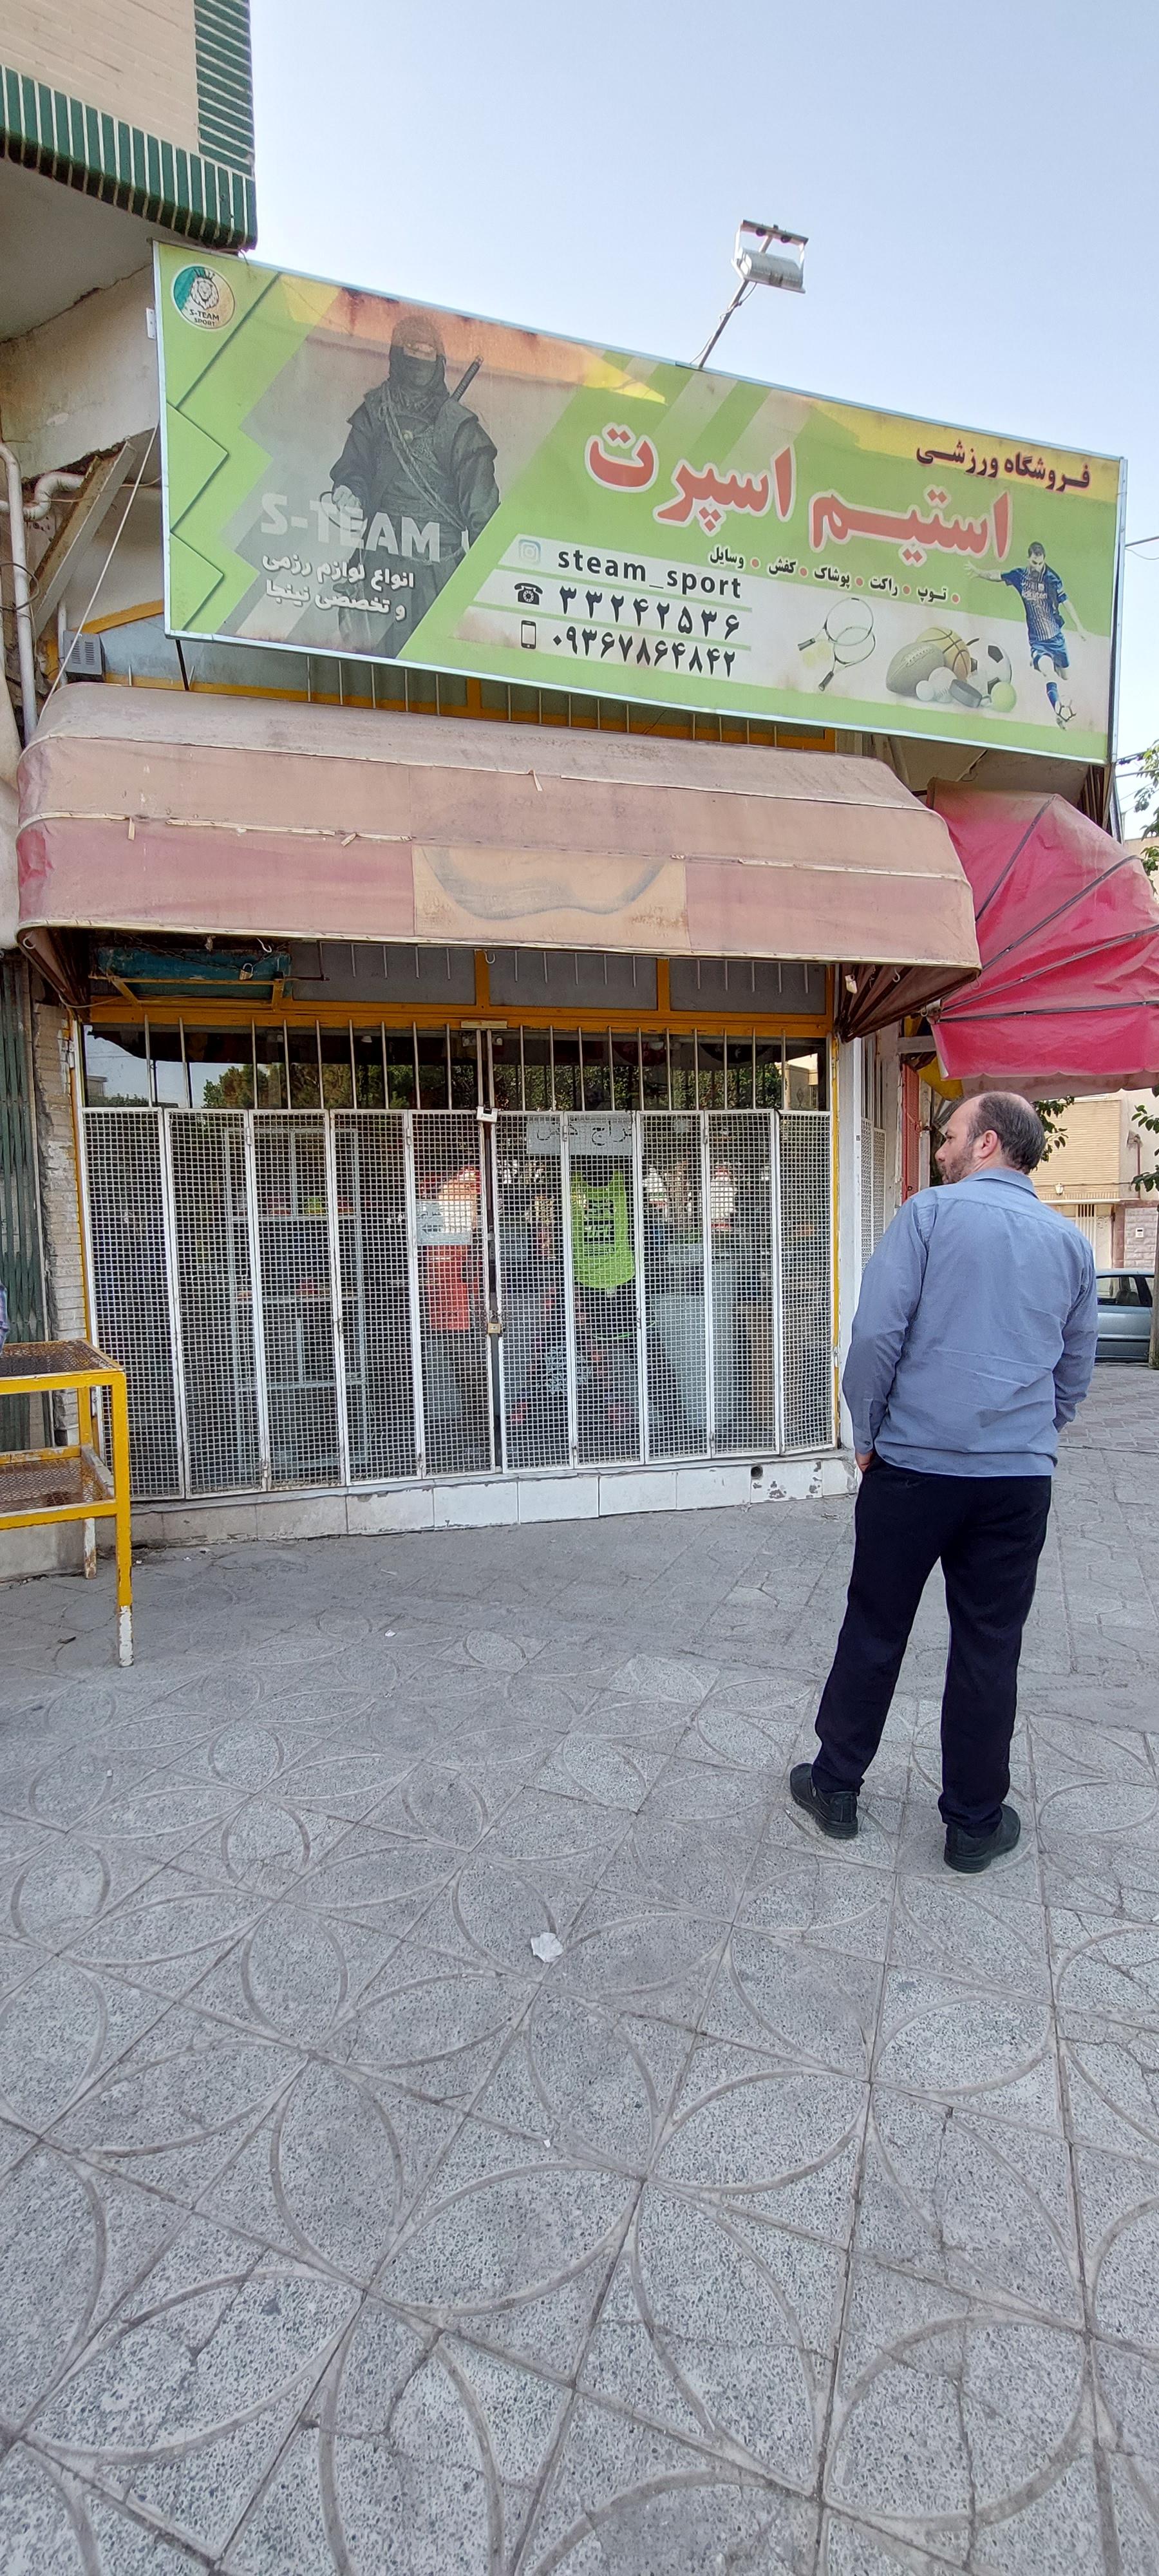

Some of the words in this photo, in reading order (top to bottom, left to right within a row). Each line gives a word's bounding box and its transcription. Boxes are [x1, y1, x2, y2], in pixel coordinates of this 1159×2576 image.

[189, 309, 220, 321] S-TEAM
[194, 317, 216, 327] SPORT
[916, 439, 999, 478] ورزشی
[589, 427, 793, 533] اسپرت
[1004, 451, 1090, 492] فروشگاه
[260, 492, 441, 564] S-TEAM
[812, 488, 1009, 564] استیم
[262, 554, 312, 577] رزمی
[710, 547, 744, 569] وسایل
[768, 558, 796, 575] کفش
[316, 560, 366, 583] لوازم
[370, 568, 415, 592] انواع
[558, 549, 742, 599] steam_sport
[814, 567, 851, 589] پوشاک
[265, 579, 310, 607] نینجا
[870, 578, 898, 596] راکت
[917, 587, 947, 603] توپ
[314, 592, 391, 614] تخصصی
[395, 604, 407, 621] و
[552, 625, 736, 678] ۰۹۳۶۷۸۶۴۸۴۲
